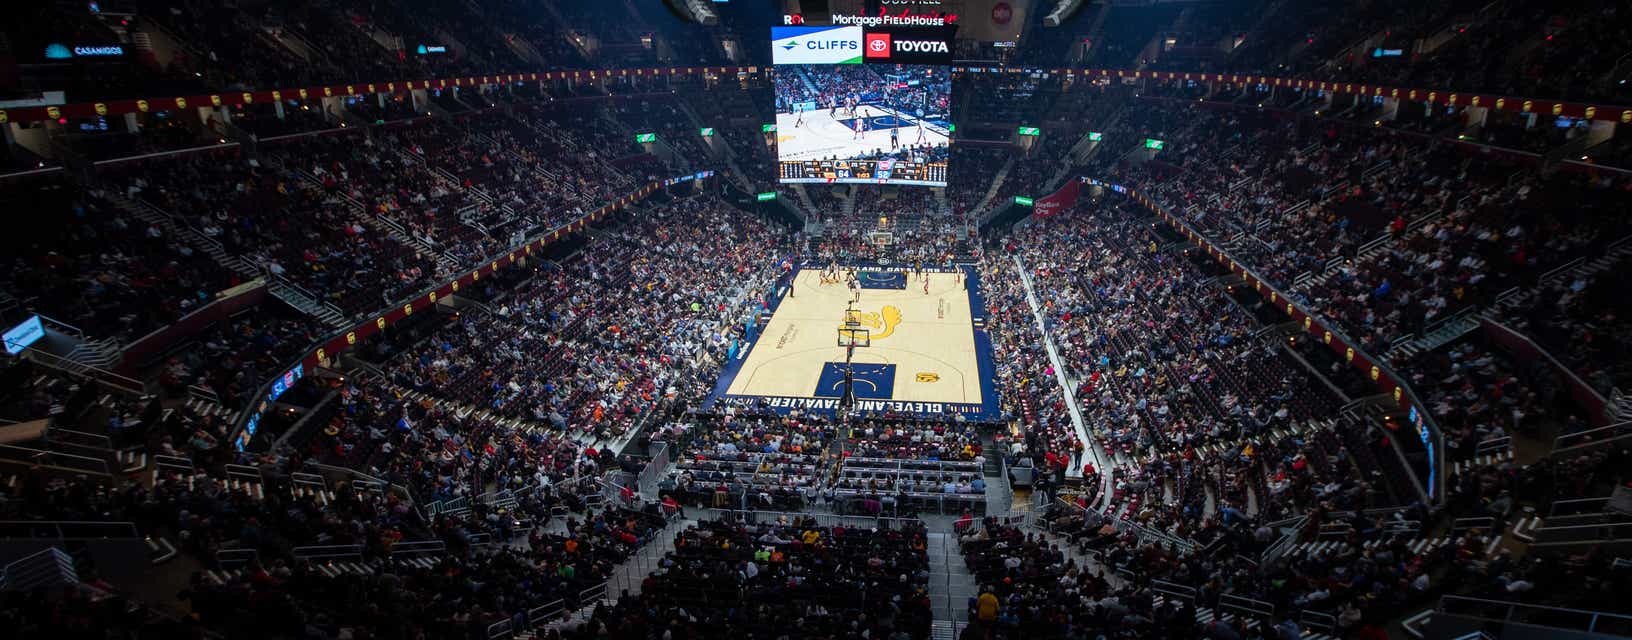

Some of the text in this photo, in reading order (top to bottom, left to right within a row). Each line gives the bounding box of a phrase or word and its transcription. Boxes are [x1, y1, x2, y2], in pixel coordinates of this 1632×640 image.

[832, 14, 882, 27] Mortgage
[806, 40, 858, 50] CLIFFS
[894, 40, 949, 53] TOYOTA
